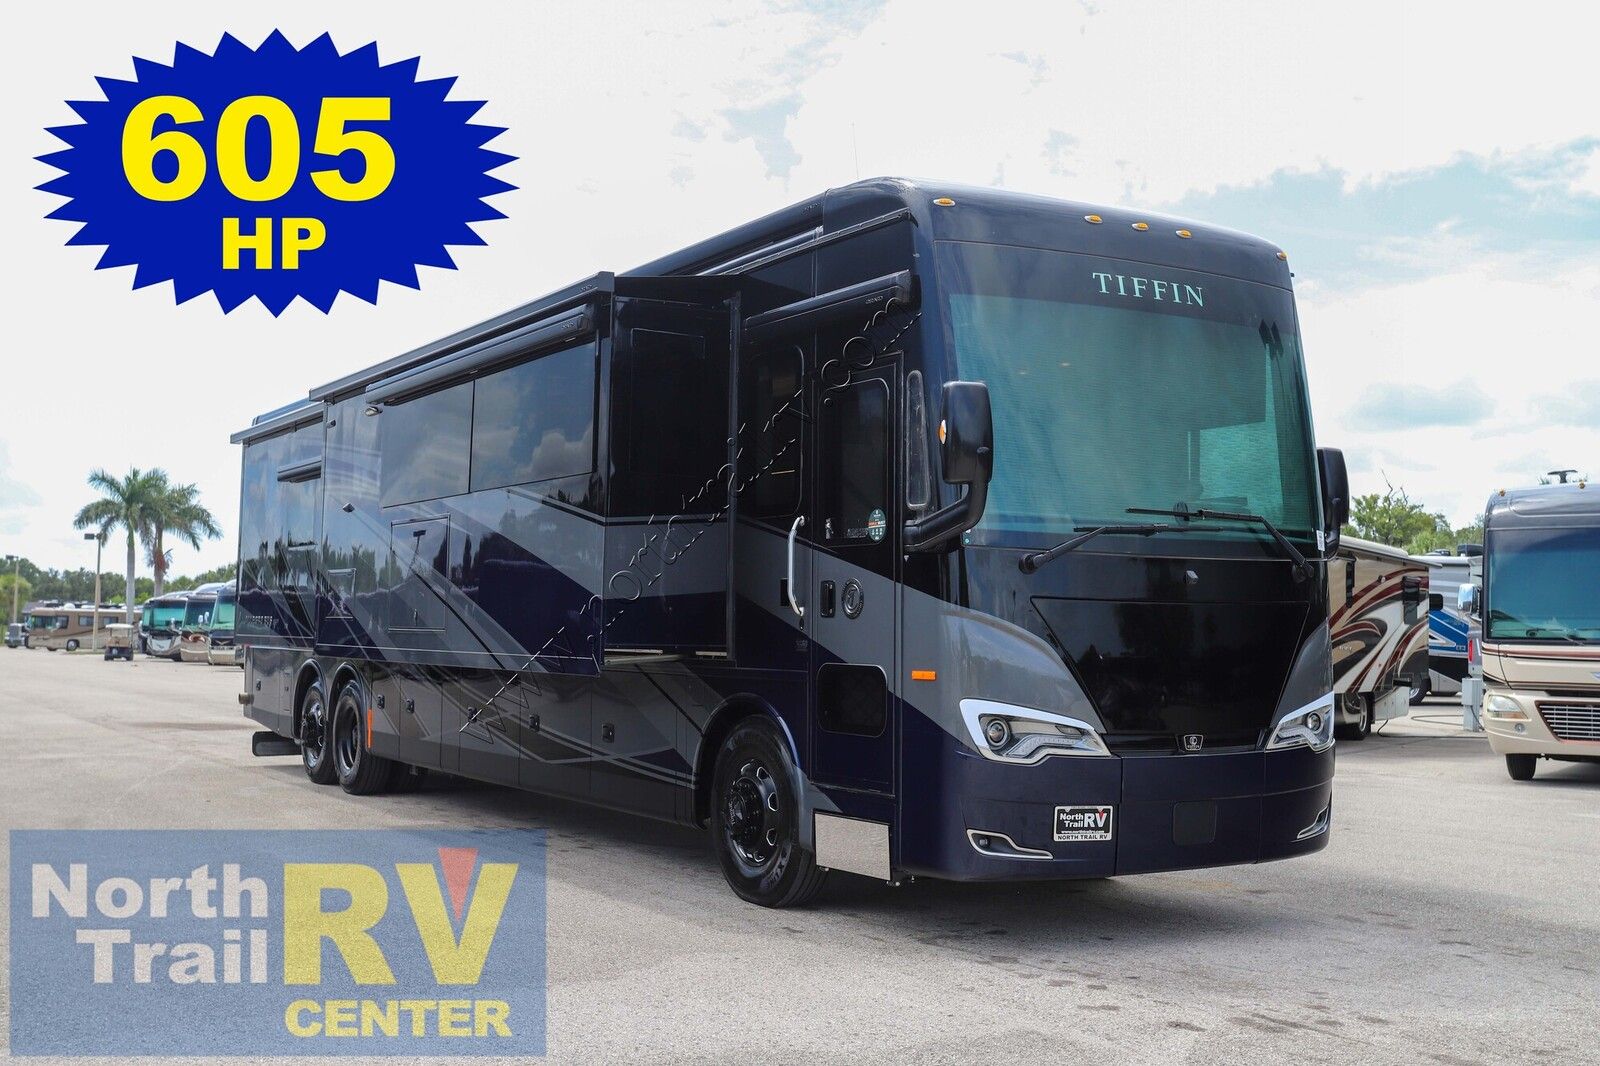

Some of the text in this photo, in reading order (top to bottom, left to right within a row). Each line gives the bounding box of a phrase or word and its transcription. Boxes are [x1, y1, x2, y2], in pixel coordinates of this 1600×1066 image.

[1092, 271, 1205, 308] TIFFIN
[1059, 812, 1083, 821] North
[1063, 812, 1108, 828] Trail RV
